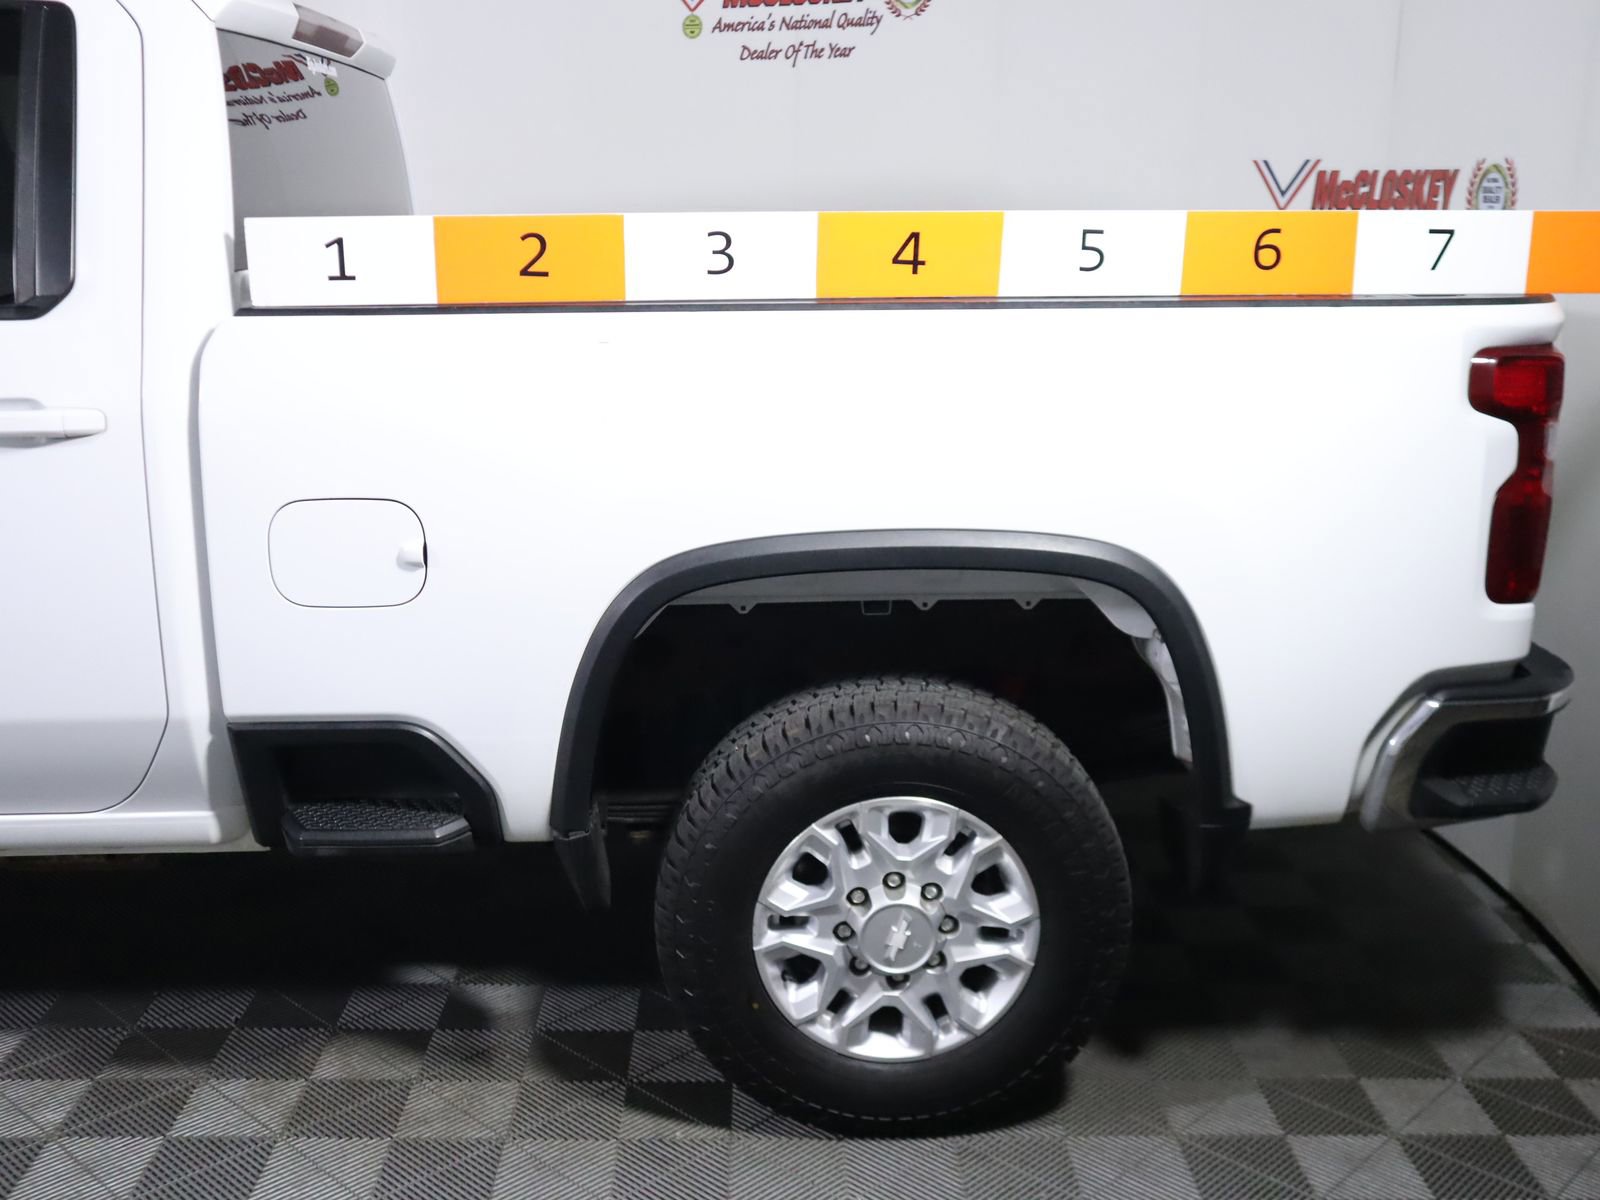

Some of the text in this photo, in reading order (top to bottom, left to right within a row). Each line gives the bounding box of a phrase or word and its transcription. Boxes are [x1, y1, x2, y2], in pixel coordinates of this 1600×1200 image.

[711, 13, 776, 34] America's
[778, 10, 833, 32] National
[836, 8, 884, 36] Quality
[739, 40, 856, 68] Dealer Of The Year
[1312, 169, 1460, 210] McCLOSKEY
